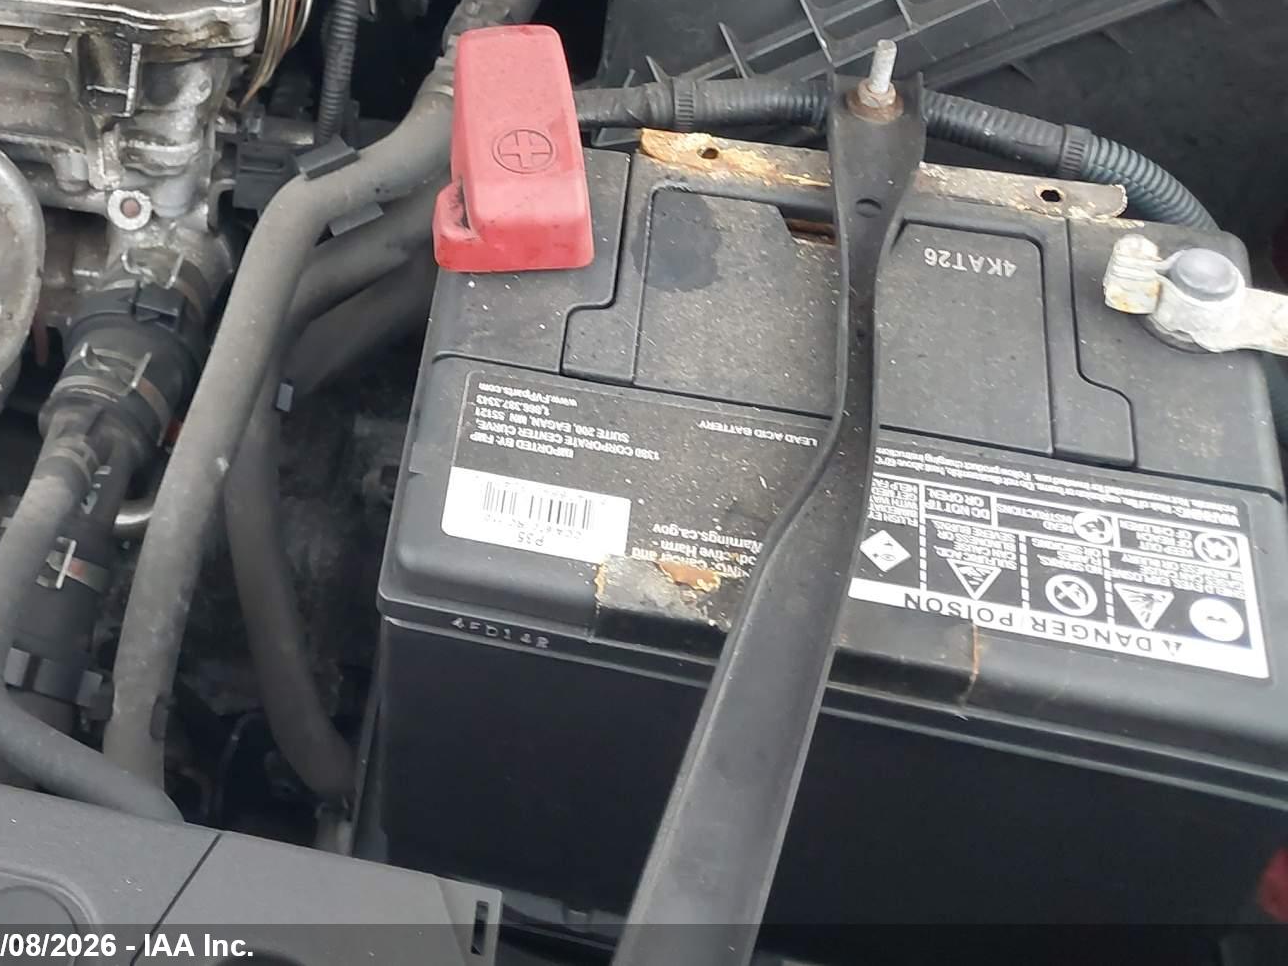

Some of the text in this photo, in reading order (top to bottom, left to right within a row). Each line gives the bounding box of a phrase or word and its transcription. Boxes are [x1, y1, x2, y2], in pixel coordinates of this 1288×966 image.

[924, 248, 1017, 278] 4KAT26
[510, 413, 528, 424] MN
[530, 416, 572, 433] EAGAN,
[495, 434, 515, 448] BY:
[517, 426, 563, 444] CENTER
[596, 427, 630, 443] SUITE
[698, 419, 818, 447] LEAD ACID BATTERY
[516, 439, 574, 459] IMPORTED
[564, 434, 633, 456] CORPORATE
[888, 480, 918, 493] HELP
[941, 502, 971, 516] NOT
[963, 495, 985, 507] OR
[995, 503, 1074, 525] INSTRUCTIONS
[935, 529, 954, 540] OR
[631, 546, 657, 562] and
[660, 539, 698, 557] Harm
[951, 541, 990, 555] CAUSE
[904, 593, 1152, 652] DANGER POISON
